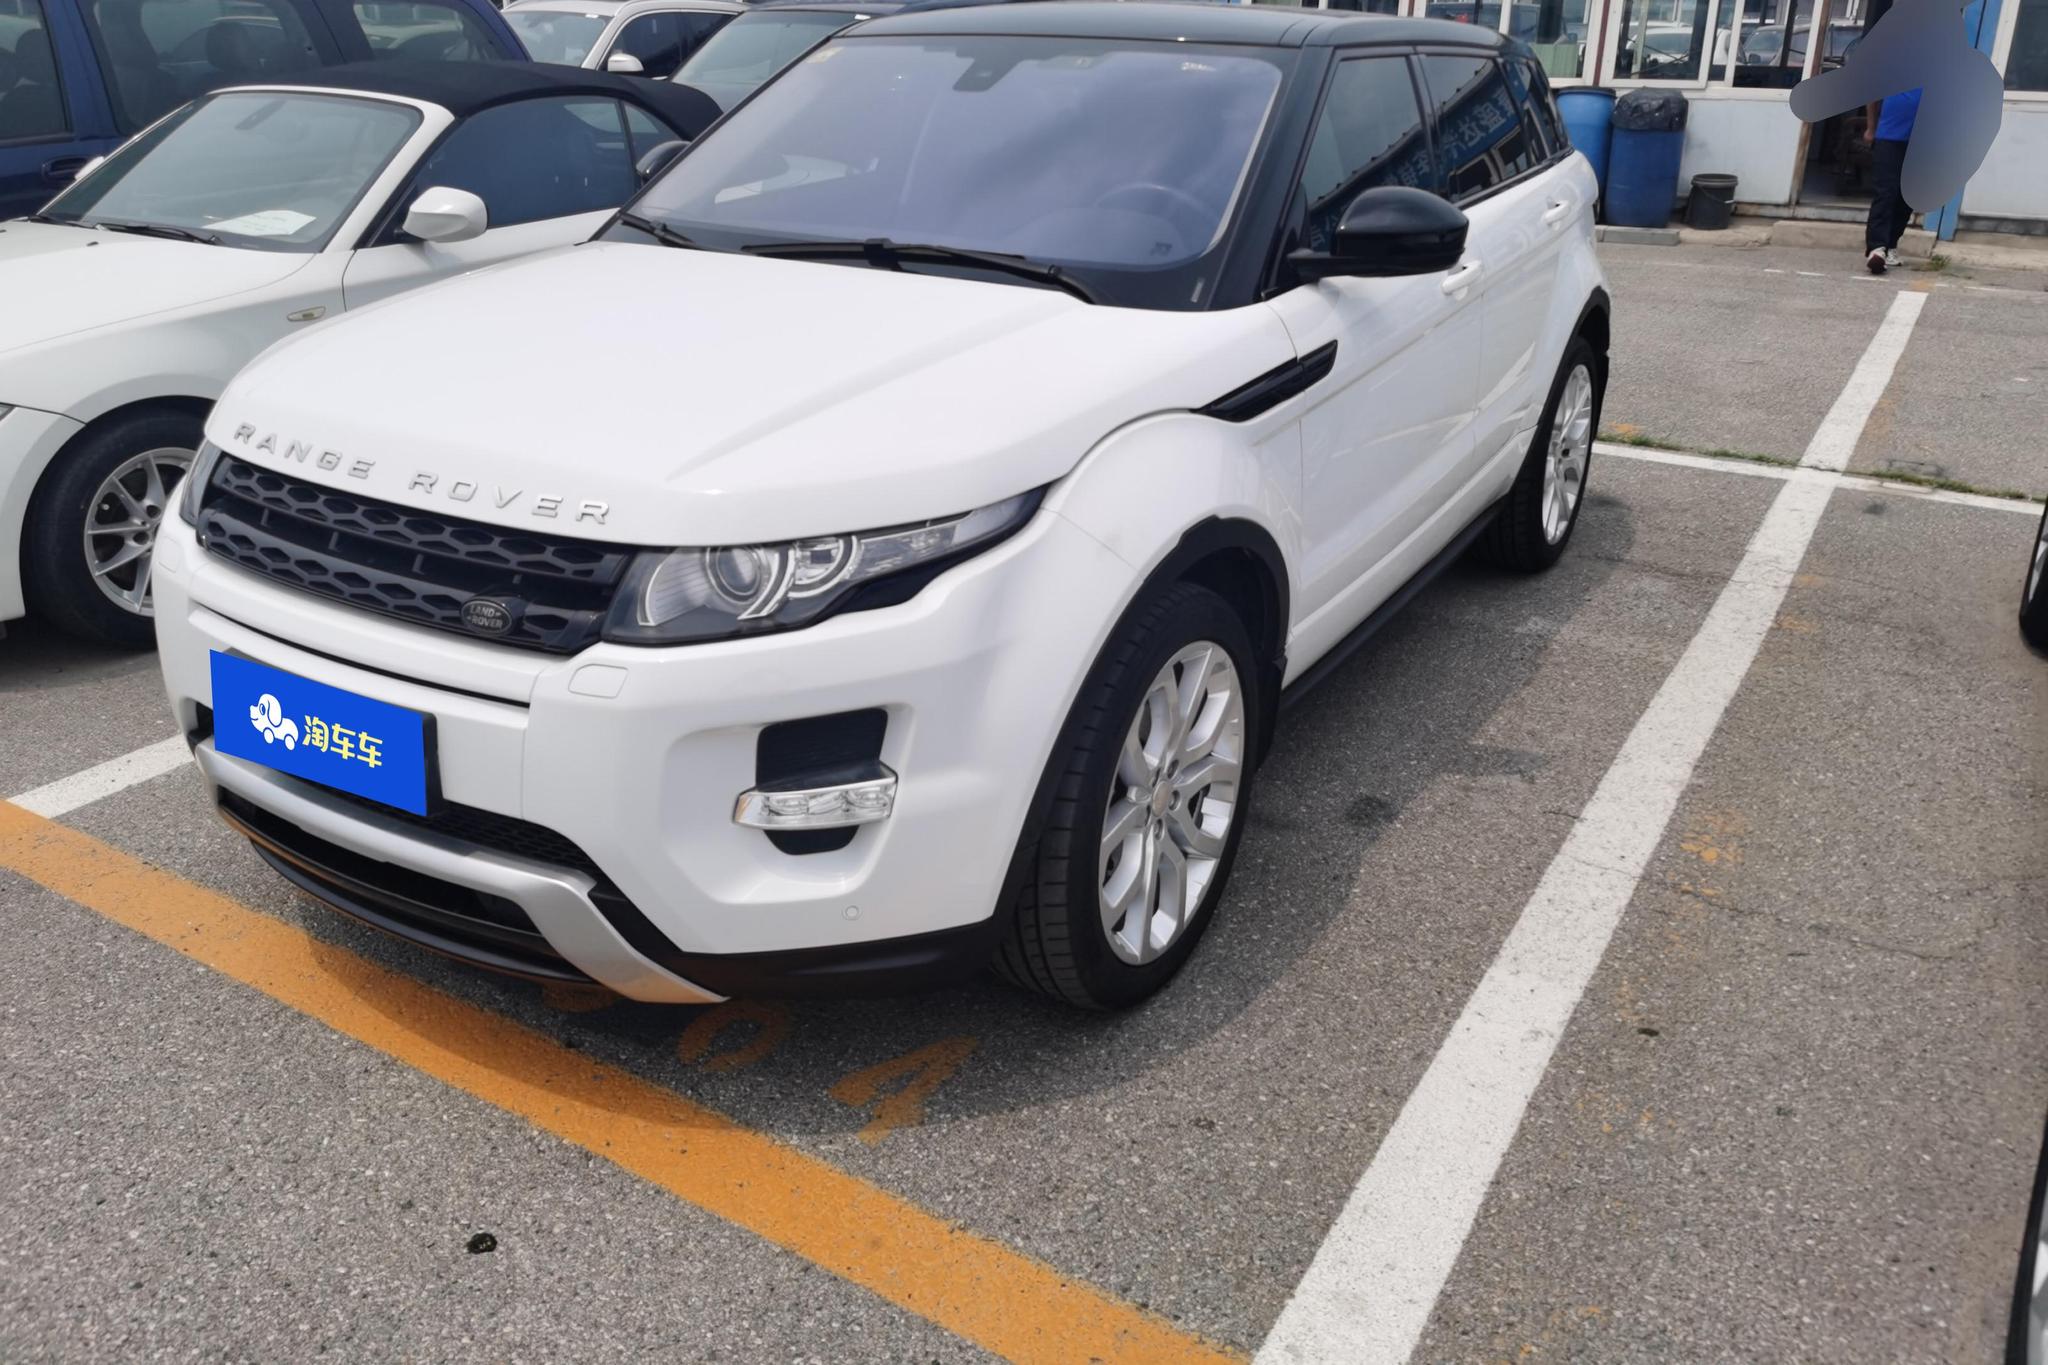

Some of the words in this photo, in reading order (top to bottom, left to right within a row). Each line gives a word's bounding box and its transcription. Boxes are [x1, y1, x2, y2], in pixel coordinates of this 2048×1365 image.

[233, 422, 376, 479] RANGE
[408, 470, 611, 525] ROVER
[469, 604, 495, 618] LAND
[471, 614, 503, 629] ROVER
